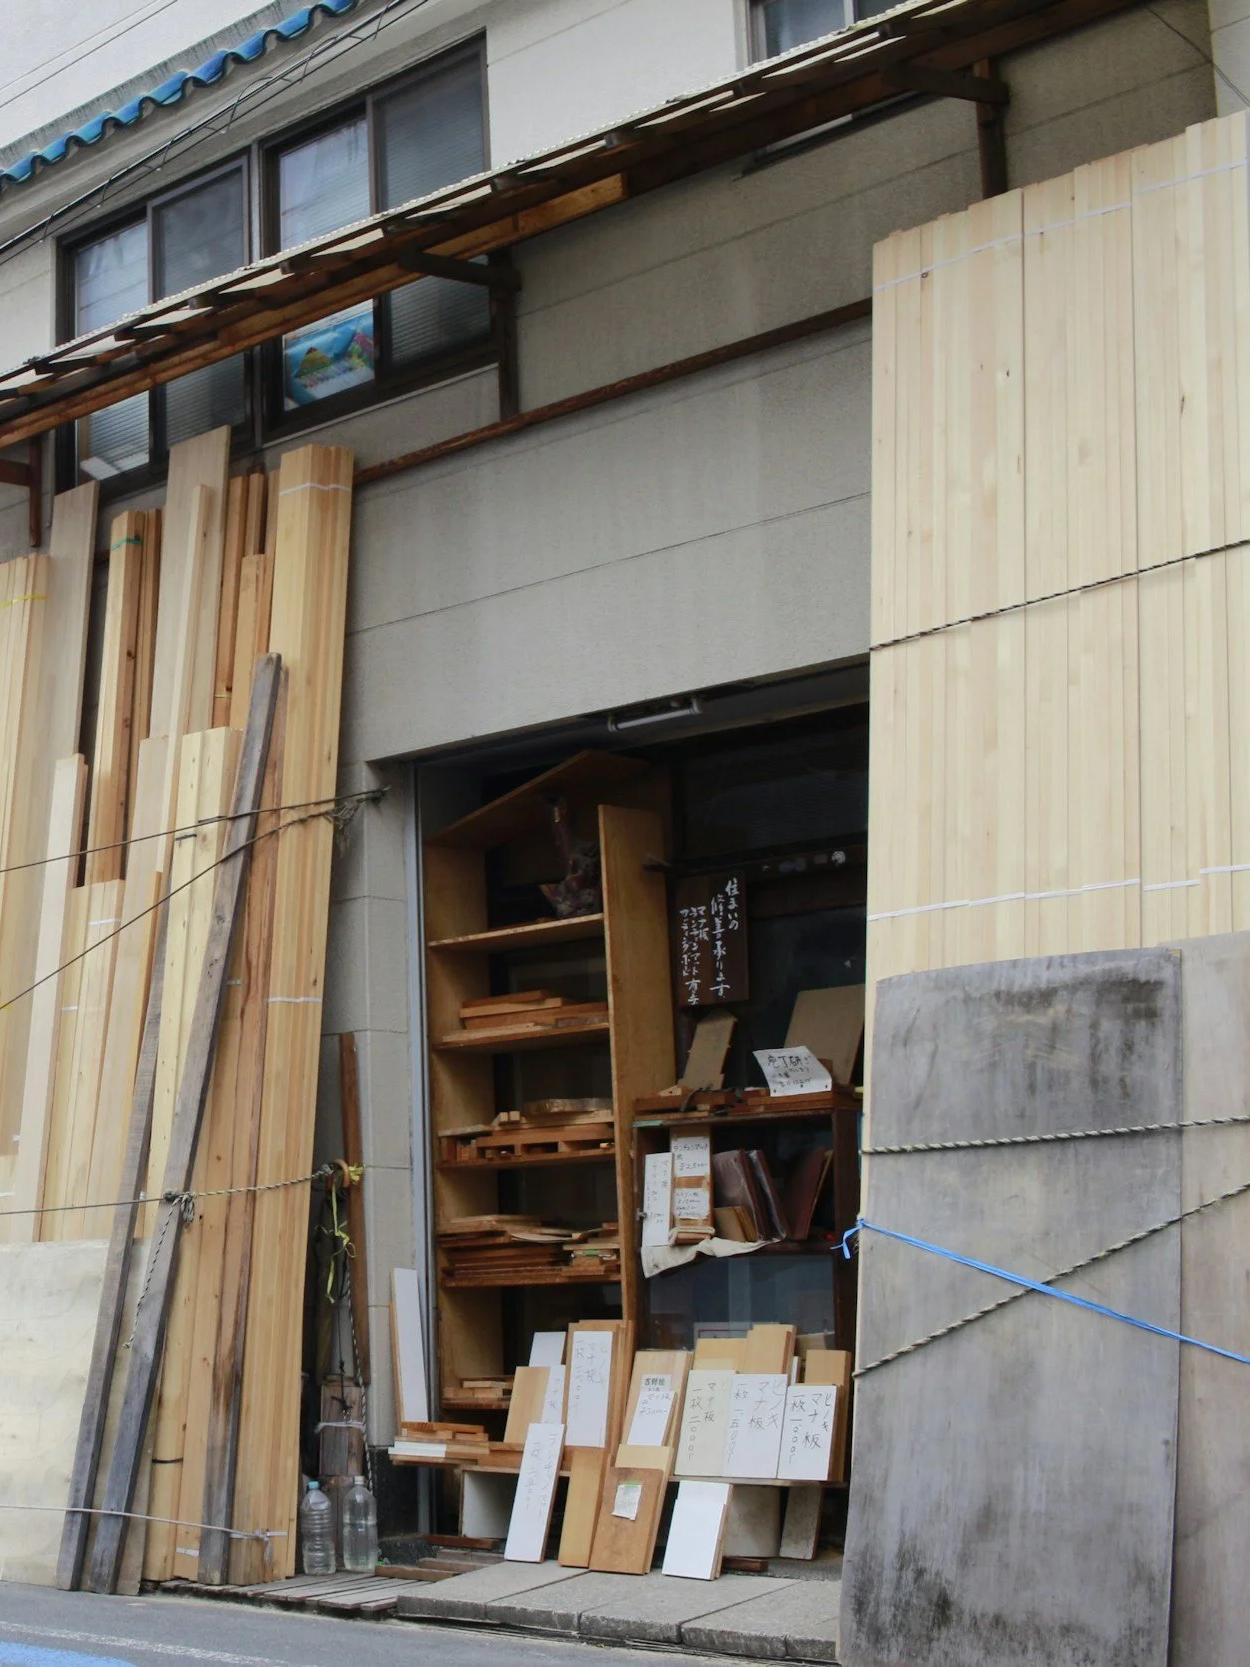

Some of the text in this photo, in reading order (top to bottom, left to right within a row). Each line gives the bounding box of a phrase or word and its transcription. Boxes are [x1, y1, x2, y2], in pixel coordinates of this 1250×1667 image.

[748, 1381, 770, 1431] マナ板
[803, 1393, 823, 1450] マナ板
